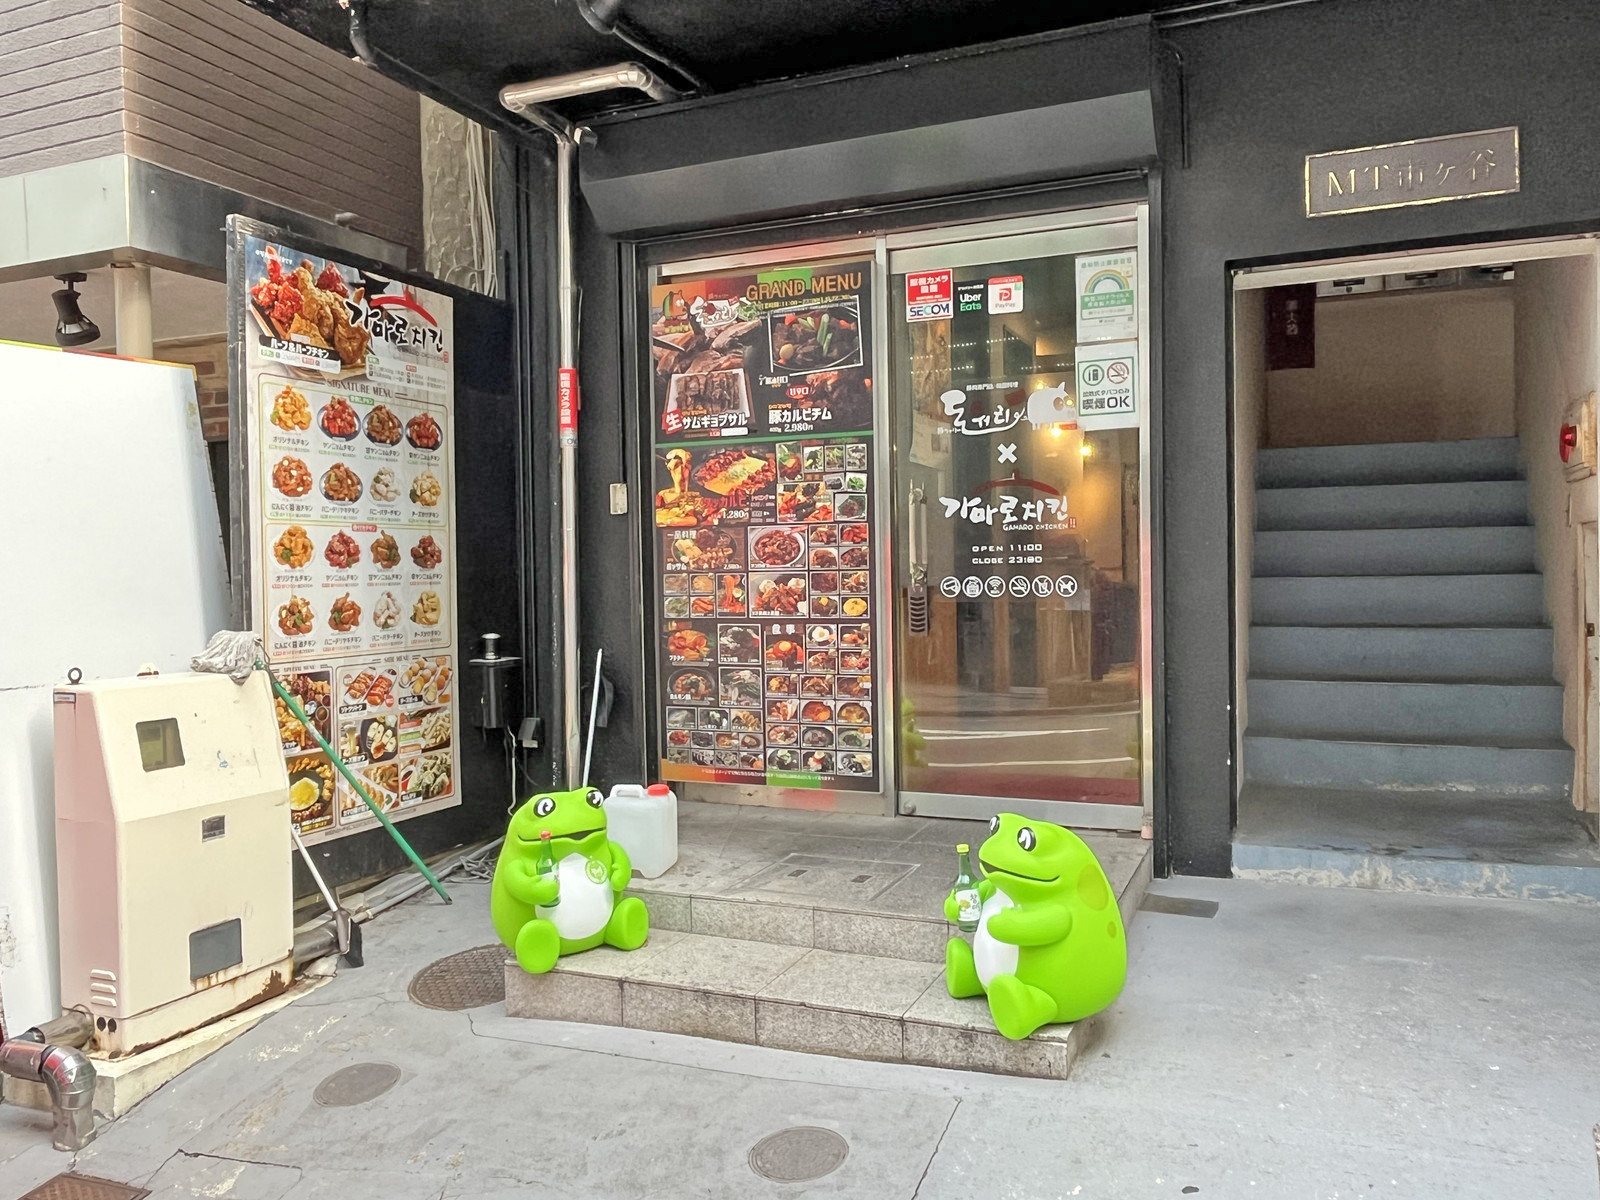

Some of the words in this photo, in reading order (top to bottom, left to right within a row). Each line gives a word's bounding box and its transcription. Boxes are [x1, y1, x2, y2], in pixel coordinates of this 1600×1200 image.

[746, 280, 805, 300] GRAND
[812, 272, 862, 294] MENU
[960, 293, 982, 302] Uber
[910, 303, 950, 317] SECOM
[960, 302, 982, 312] Eats
[327, 379, 370, 394] SIGNATURE
[372, 386, 393, 398] MENU
[1002, 523, 1033, 531] GAMARO
[1035, 523, 1068, 531] CHICKEN
[1009, 543, 1043, 551] 11:00
